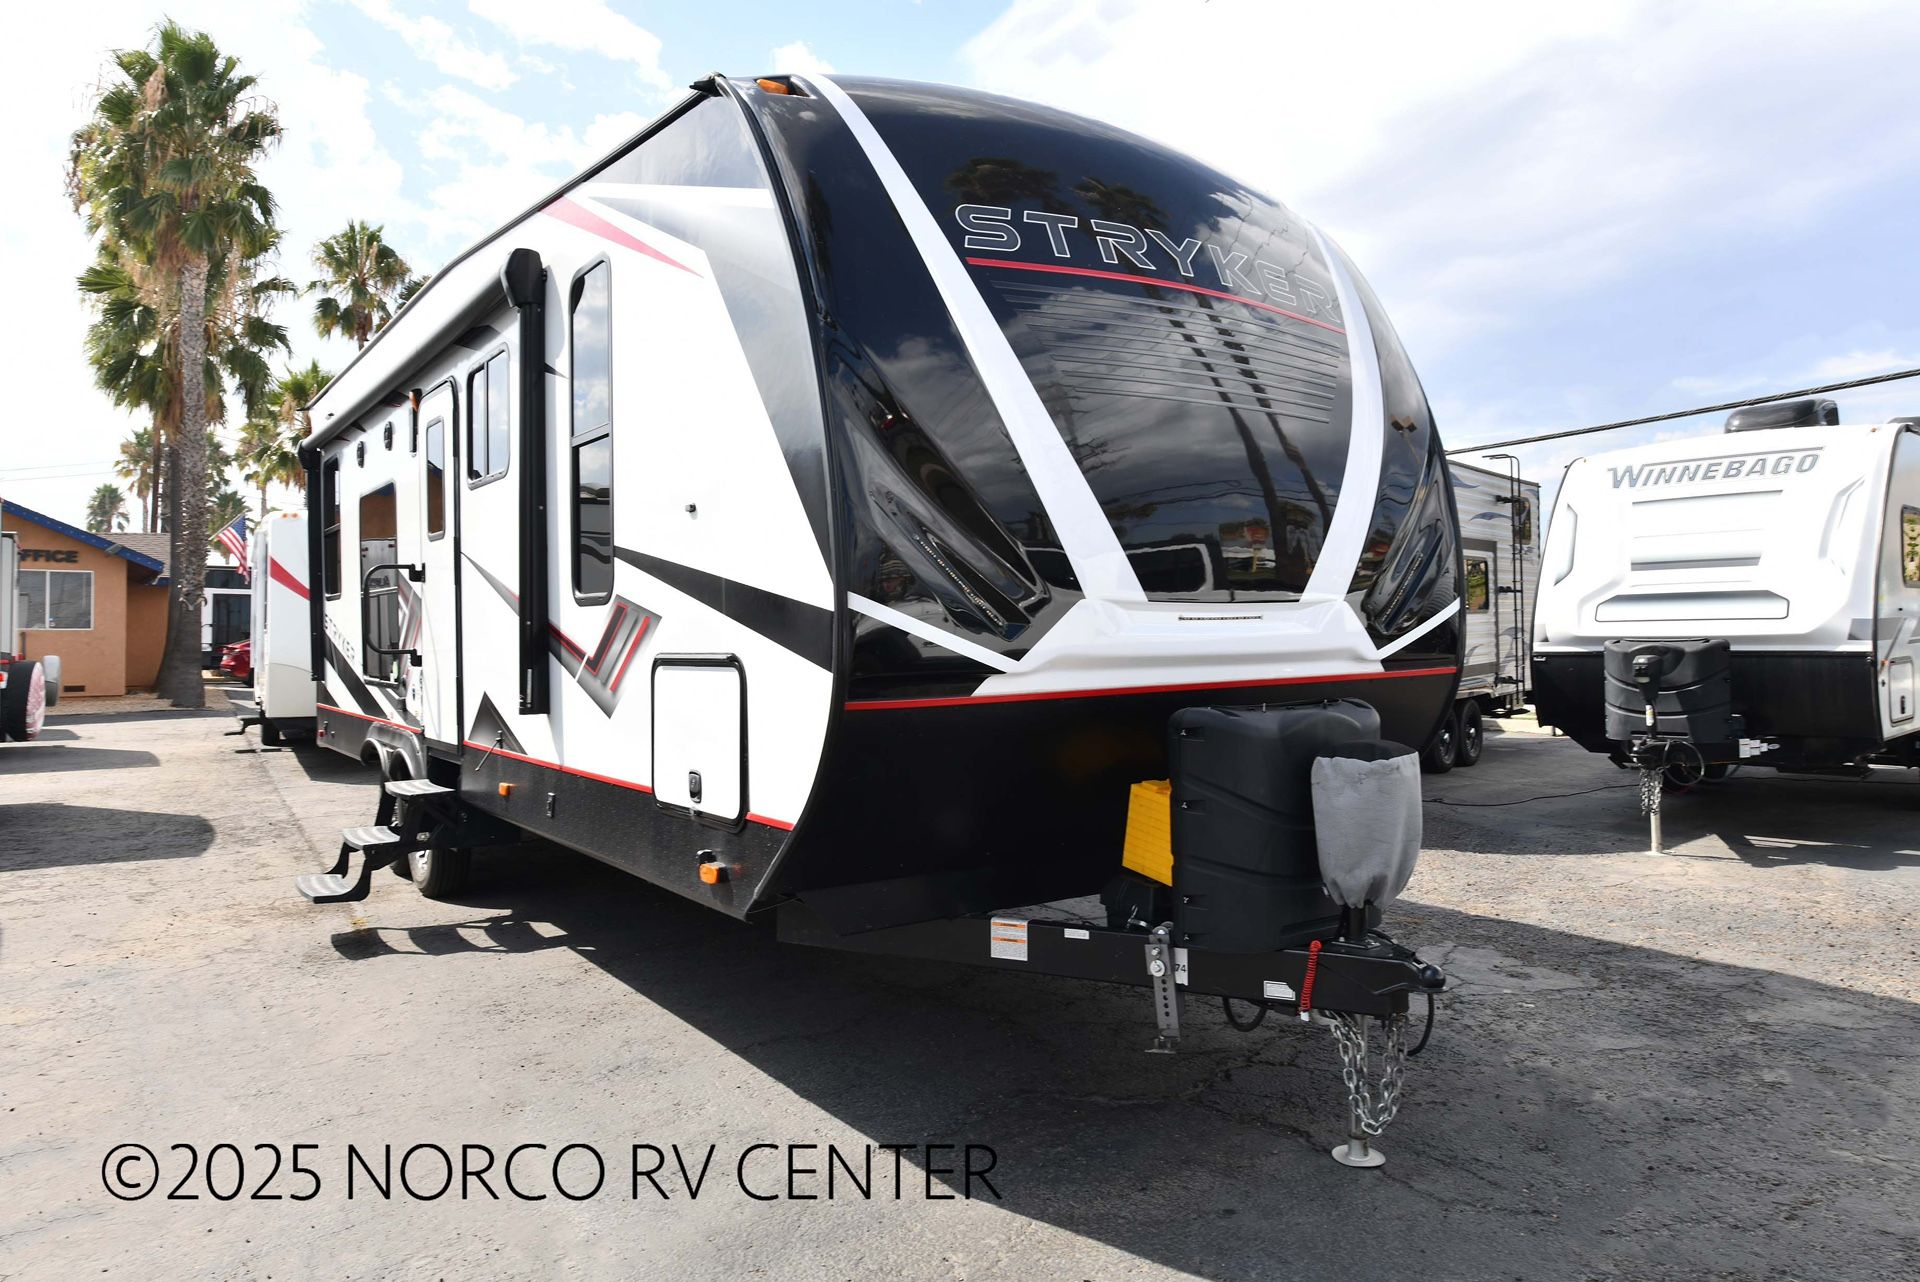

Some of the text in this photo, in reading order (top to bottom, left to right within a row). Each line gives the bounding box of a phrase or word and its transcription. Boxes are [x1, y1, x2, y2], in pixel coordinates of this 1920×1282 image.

[954, 203, 1342, 324] STRYKER
[1607, 453, 1820, 489] WINNEBAGO
[18, 548, 79, 563] FFICE
